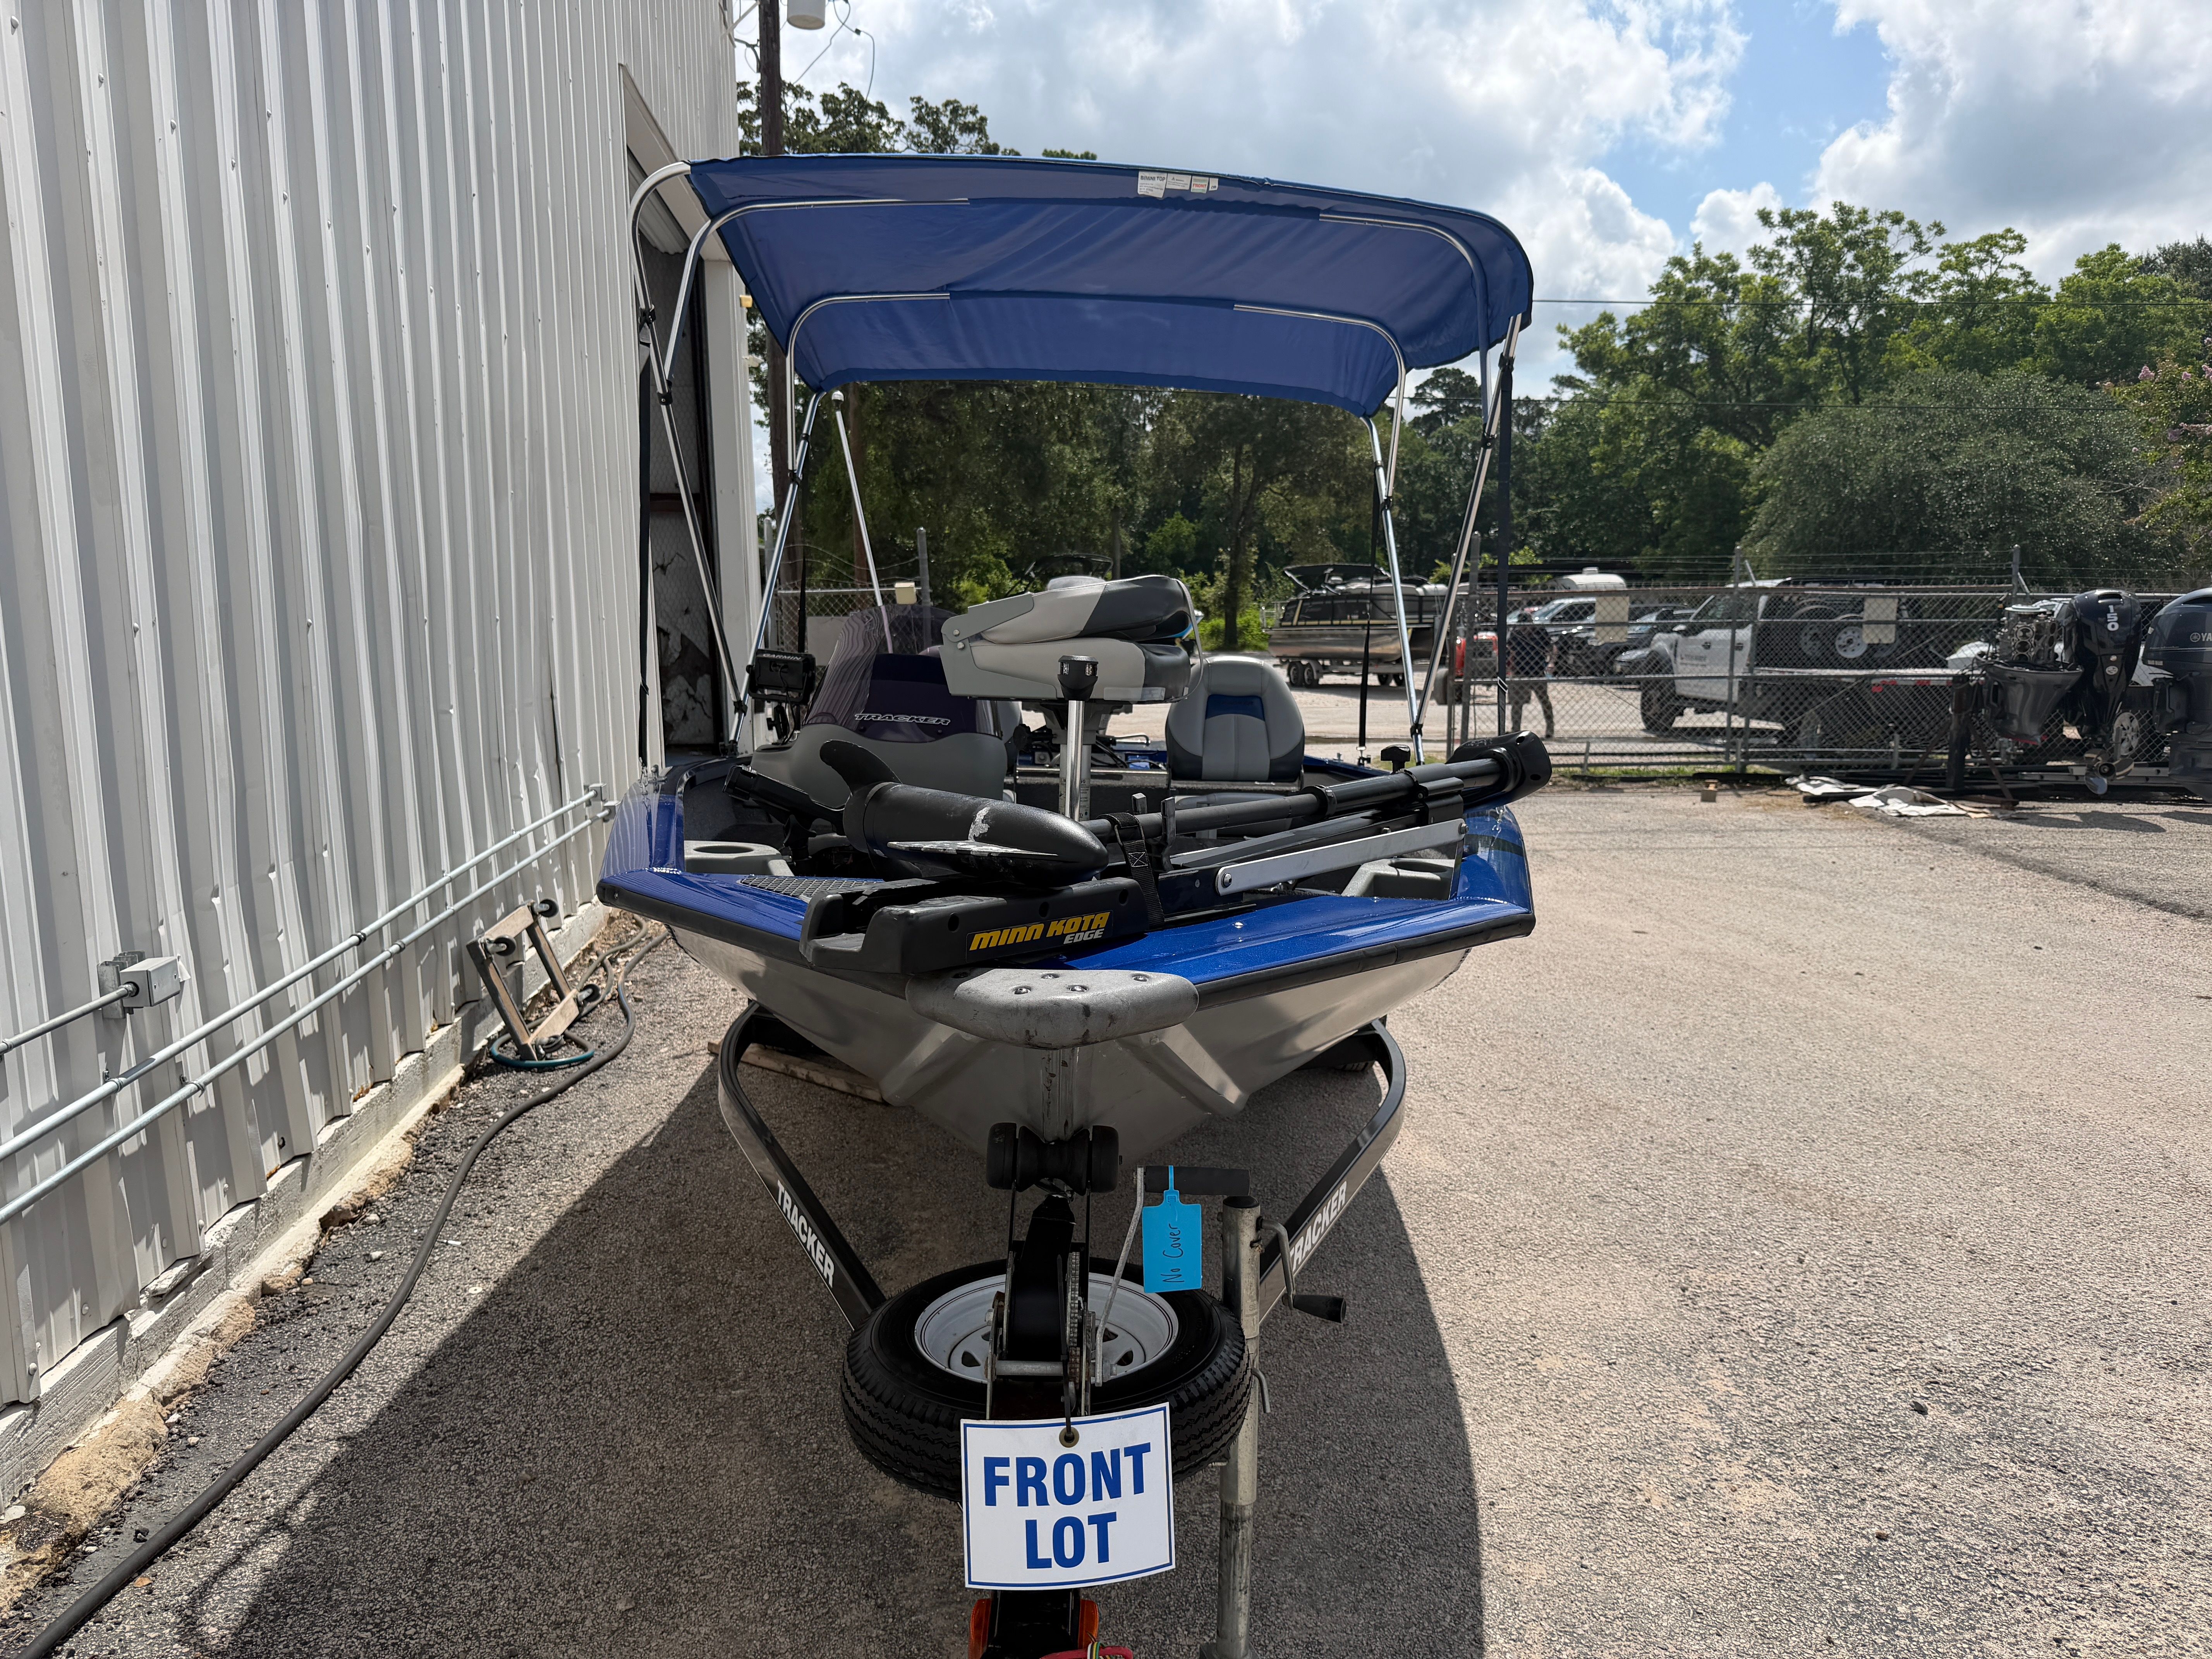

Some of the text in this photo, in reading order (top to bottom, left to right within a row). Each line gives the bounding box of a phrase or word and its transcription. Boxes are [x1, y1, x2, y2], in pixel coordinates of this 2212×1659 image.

[2107, 605, 2119, 631] 150
[855, 714, 951, 726] TRACKER
[969, 912, 1110, 951] MINN KOTA
[1063, 928, 1105, 944] EDGE
[777, 1180, 835, 1288] TRACKER
[1161, 1223, 1185, 1283] No Cover
[984, 1442, 1151, 1507] FRONT
[1025, 1511, 1117, 1569] LOT
